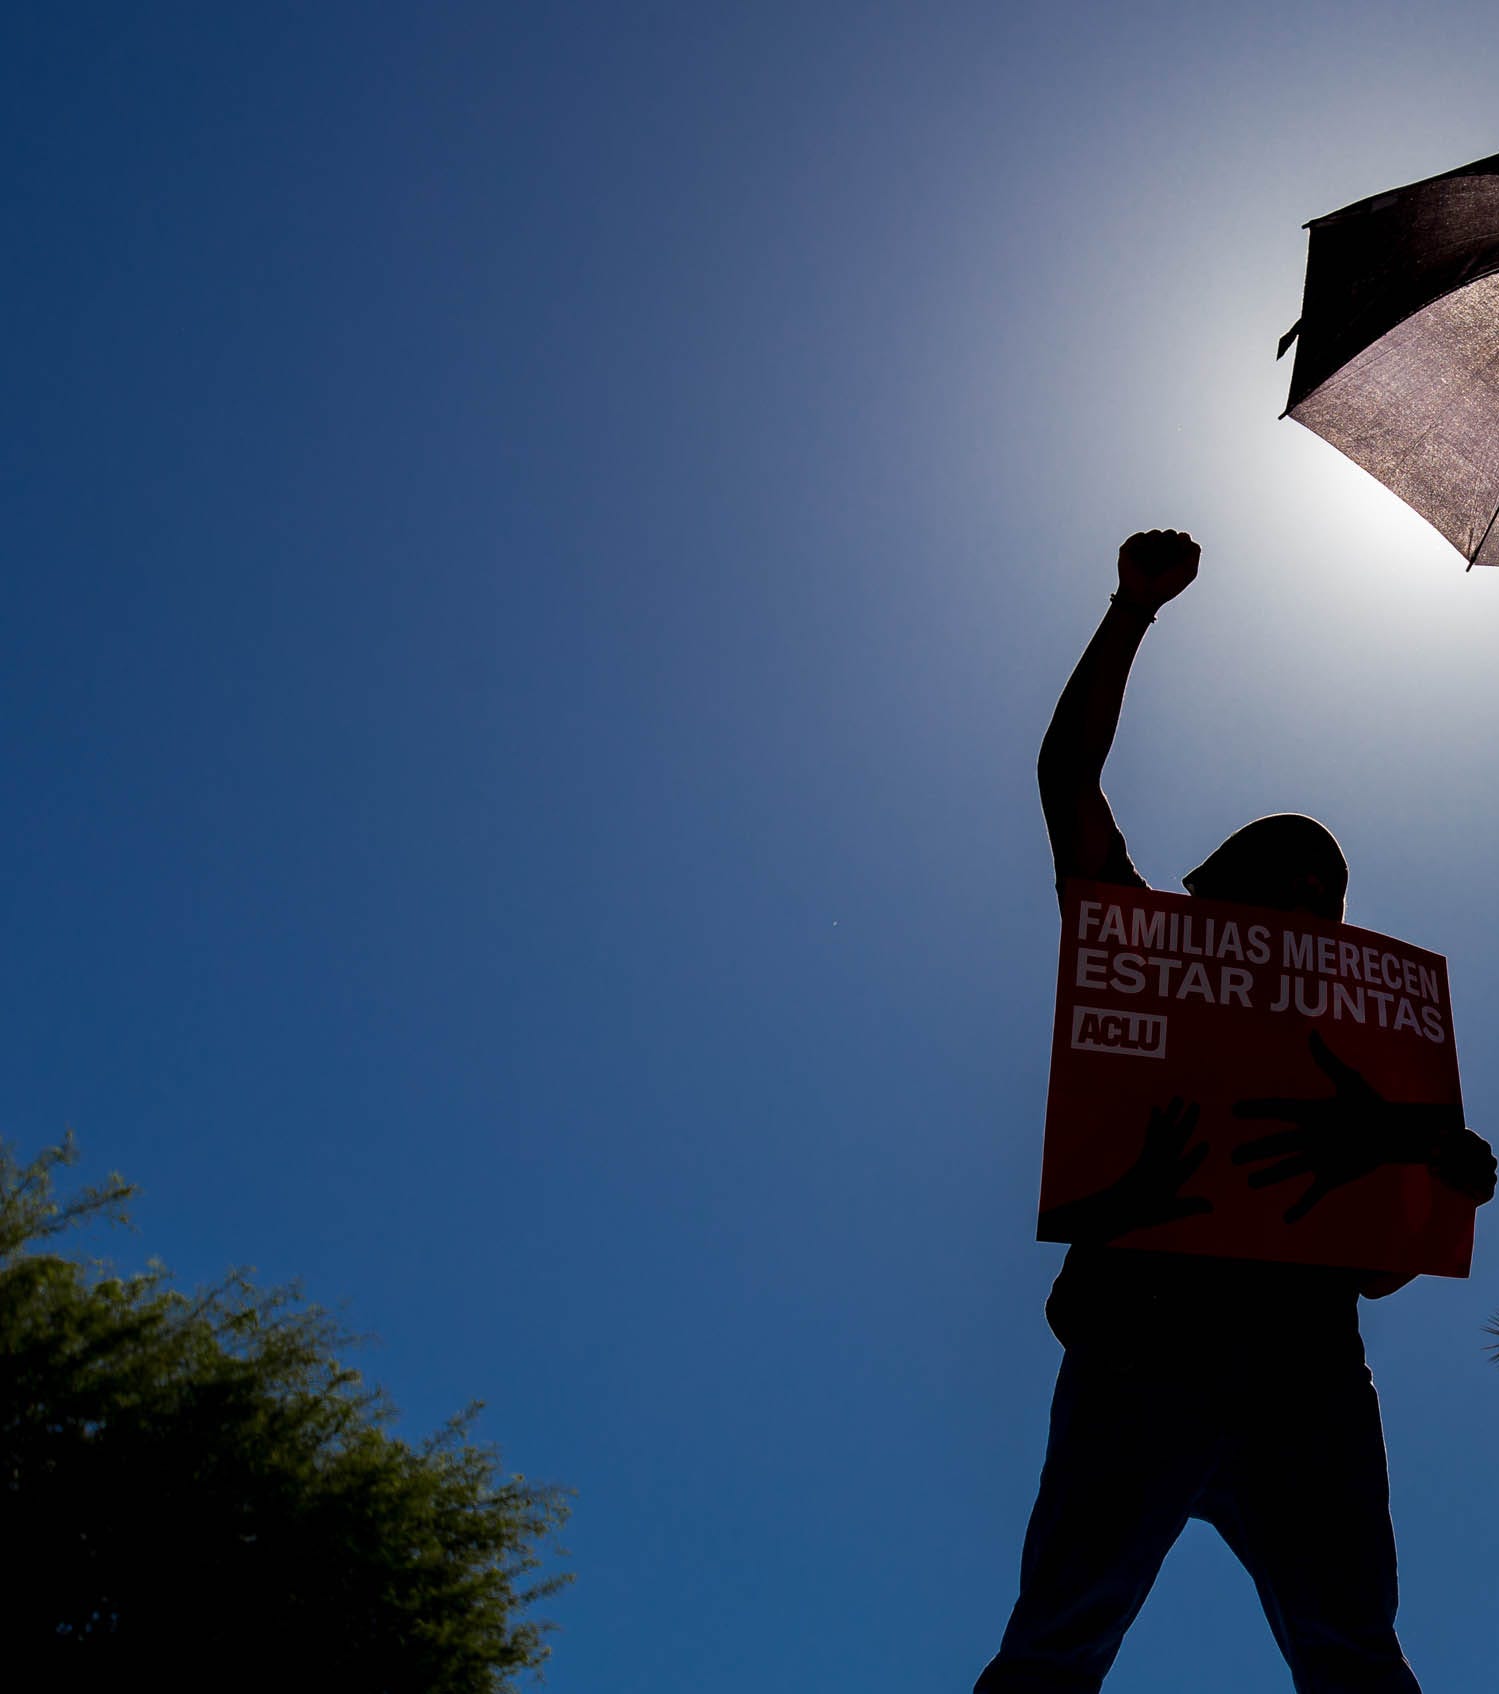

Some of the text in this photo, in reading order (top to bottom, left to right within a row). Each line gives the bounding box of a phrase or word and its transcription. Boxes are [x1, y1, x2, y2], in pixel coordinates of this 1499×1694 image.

[1075, 947, 1446, 1044] ESTAR JUNTAS
[1077, 900, 1440, 1004] FAMILIAS MERECEN
[1077, 1011, 1163, 1052] ACLU
